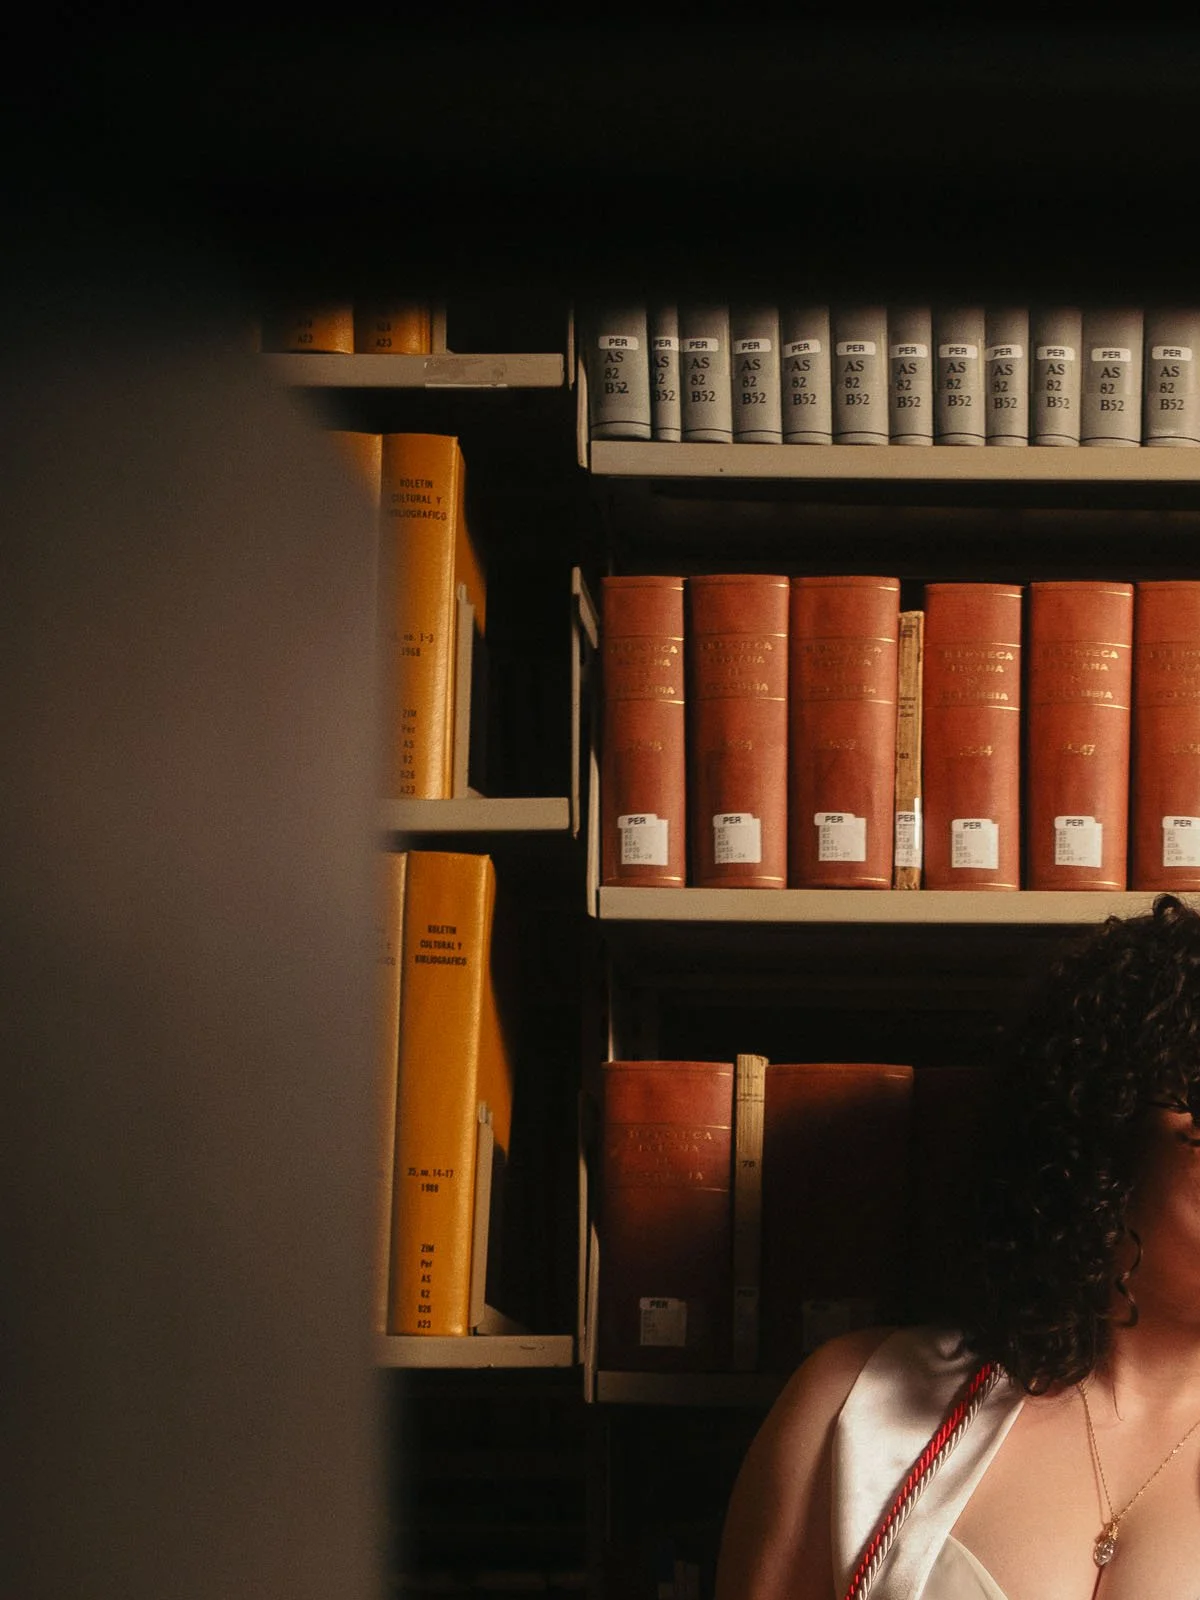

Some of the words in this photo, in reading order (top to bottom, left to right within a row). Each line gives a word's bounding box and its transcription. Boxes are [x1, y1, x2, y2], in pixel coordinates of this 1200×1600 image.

[608, 337, 628, 347] PER
[791, 343, 810, 353] PER
[948, 346, 968, 356] PER
[1101, 350, 1121, 359] PER
[605, 351, 624, 364] AS
[791, 359, 811, 372] AS
[946, 361, 966, 374] AS
[605, 368, 619, 379] 82
[1100, 366, 1121, 379] AS
[605, 382, 629, 394] B52
[791, 376, 807, 388] 82
[946, 378, 962, 390] 82
[1100, 383, 1115, 395] 82
[792, 392, 817, 405] B52
[947, 395, 972, 407] B52
[1100, 399, 1125, 412] B52
[628, 816, 646, 825] PER
[825, 815, 844, 823] PER
[963, 821, 981, 830] PER
[421, 1275, 431, 1283] AS
